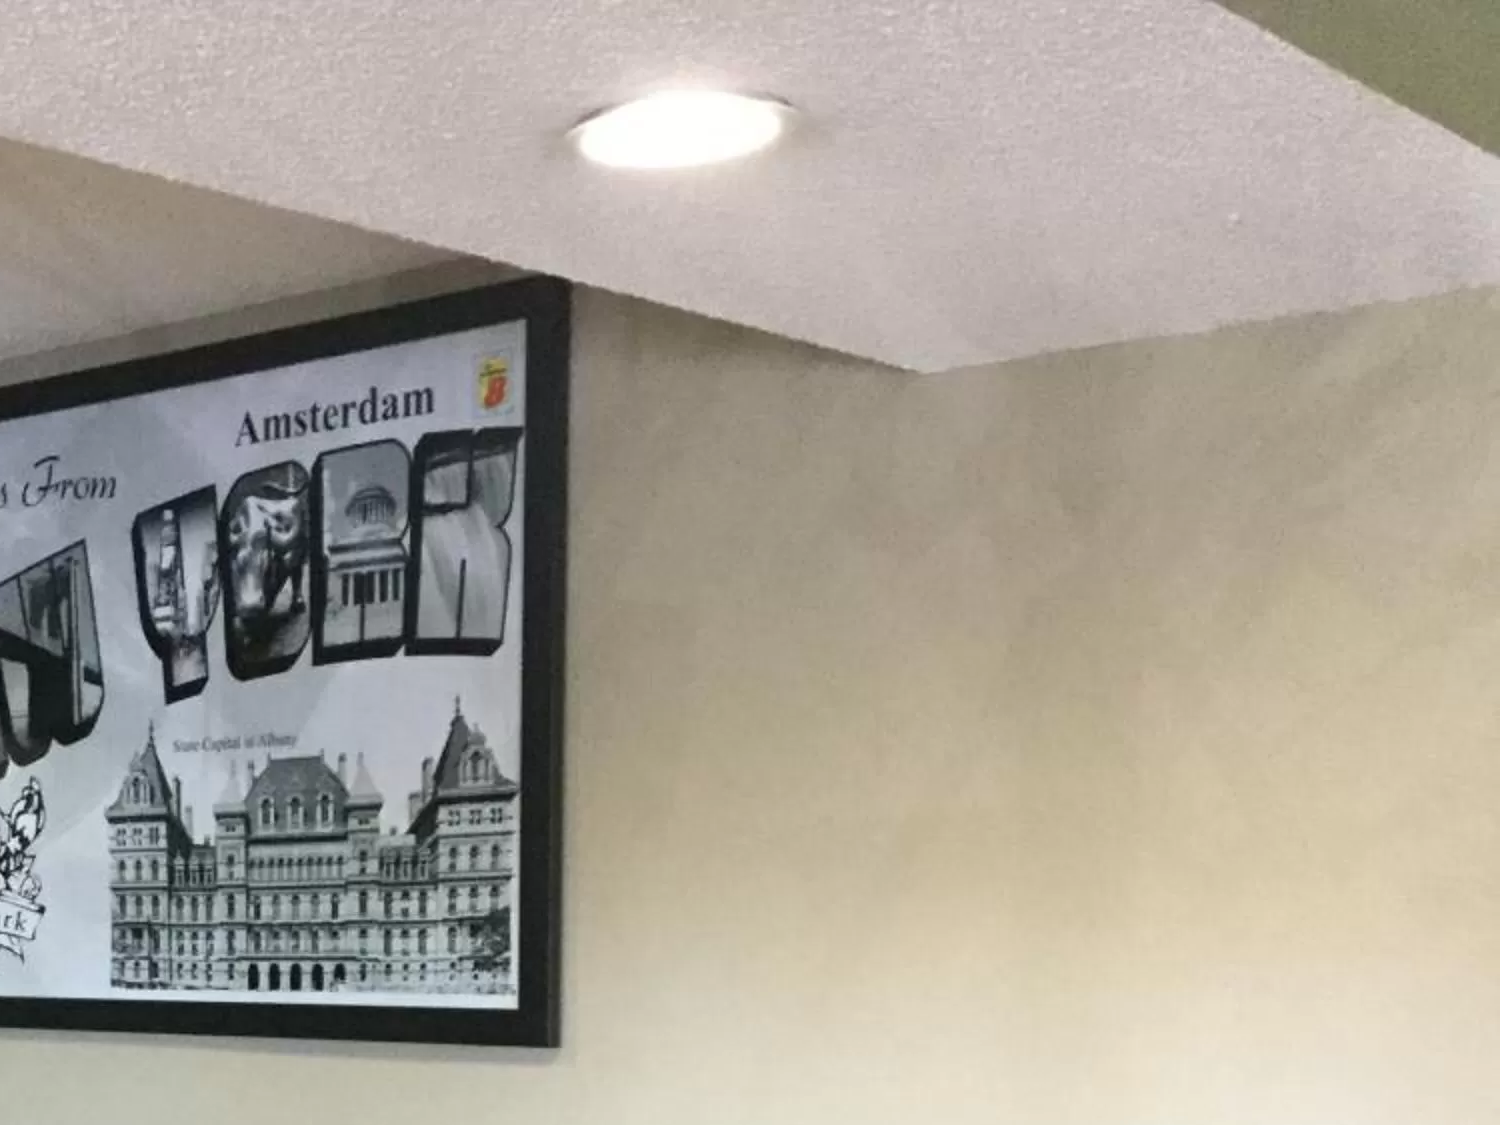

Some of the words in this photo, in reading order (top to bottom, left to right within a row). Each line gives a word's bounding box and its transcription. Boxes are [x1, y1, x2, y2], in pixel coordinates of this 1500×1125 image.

[234, 386, 435, 447] Amsterdam
[21, 454, 117, 507] From
[131, 428, 524, 705] YORK
